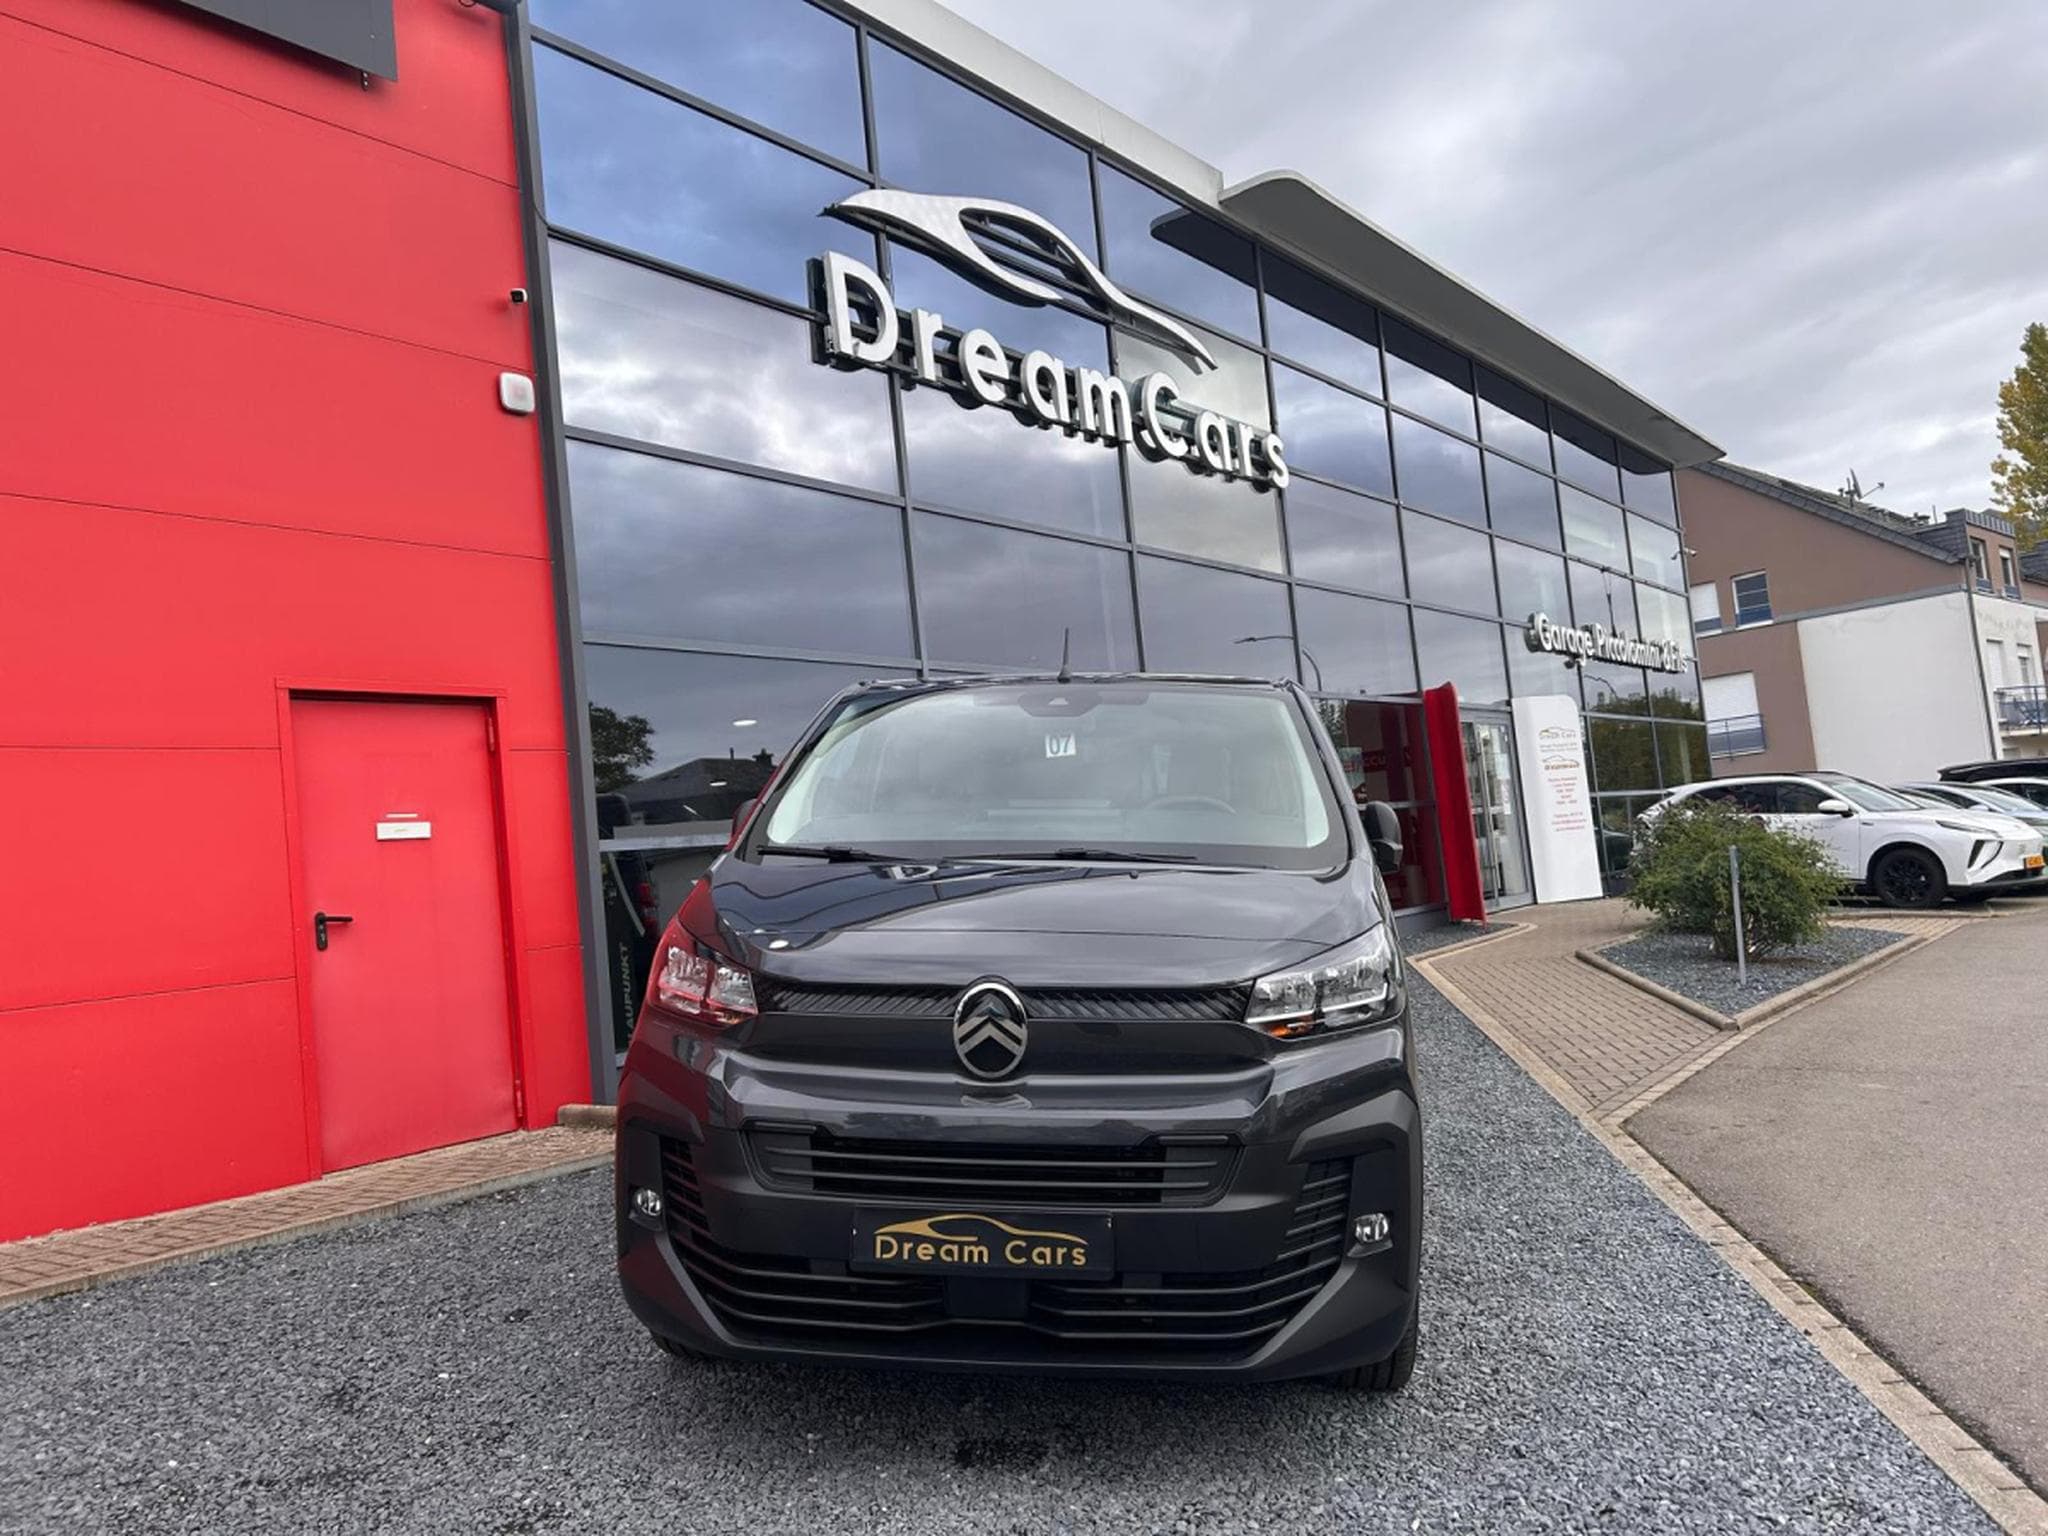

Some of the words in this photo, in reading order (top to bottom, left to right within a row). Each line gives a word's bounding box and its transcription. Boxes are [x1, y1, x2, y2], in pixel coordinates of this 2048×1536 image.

[825, 250, 1132, 443] Dream
[1140, 371, 1291, 488] Cars
[1535, 612, 1594, 666] Garage
[1048, 734, 1071, 755] 07
[874, 1235, 989, 1264] Dream
[1004, 1240, 1087, 1266] Cars
